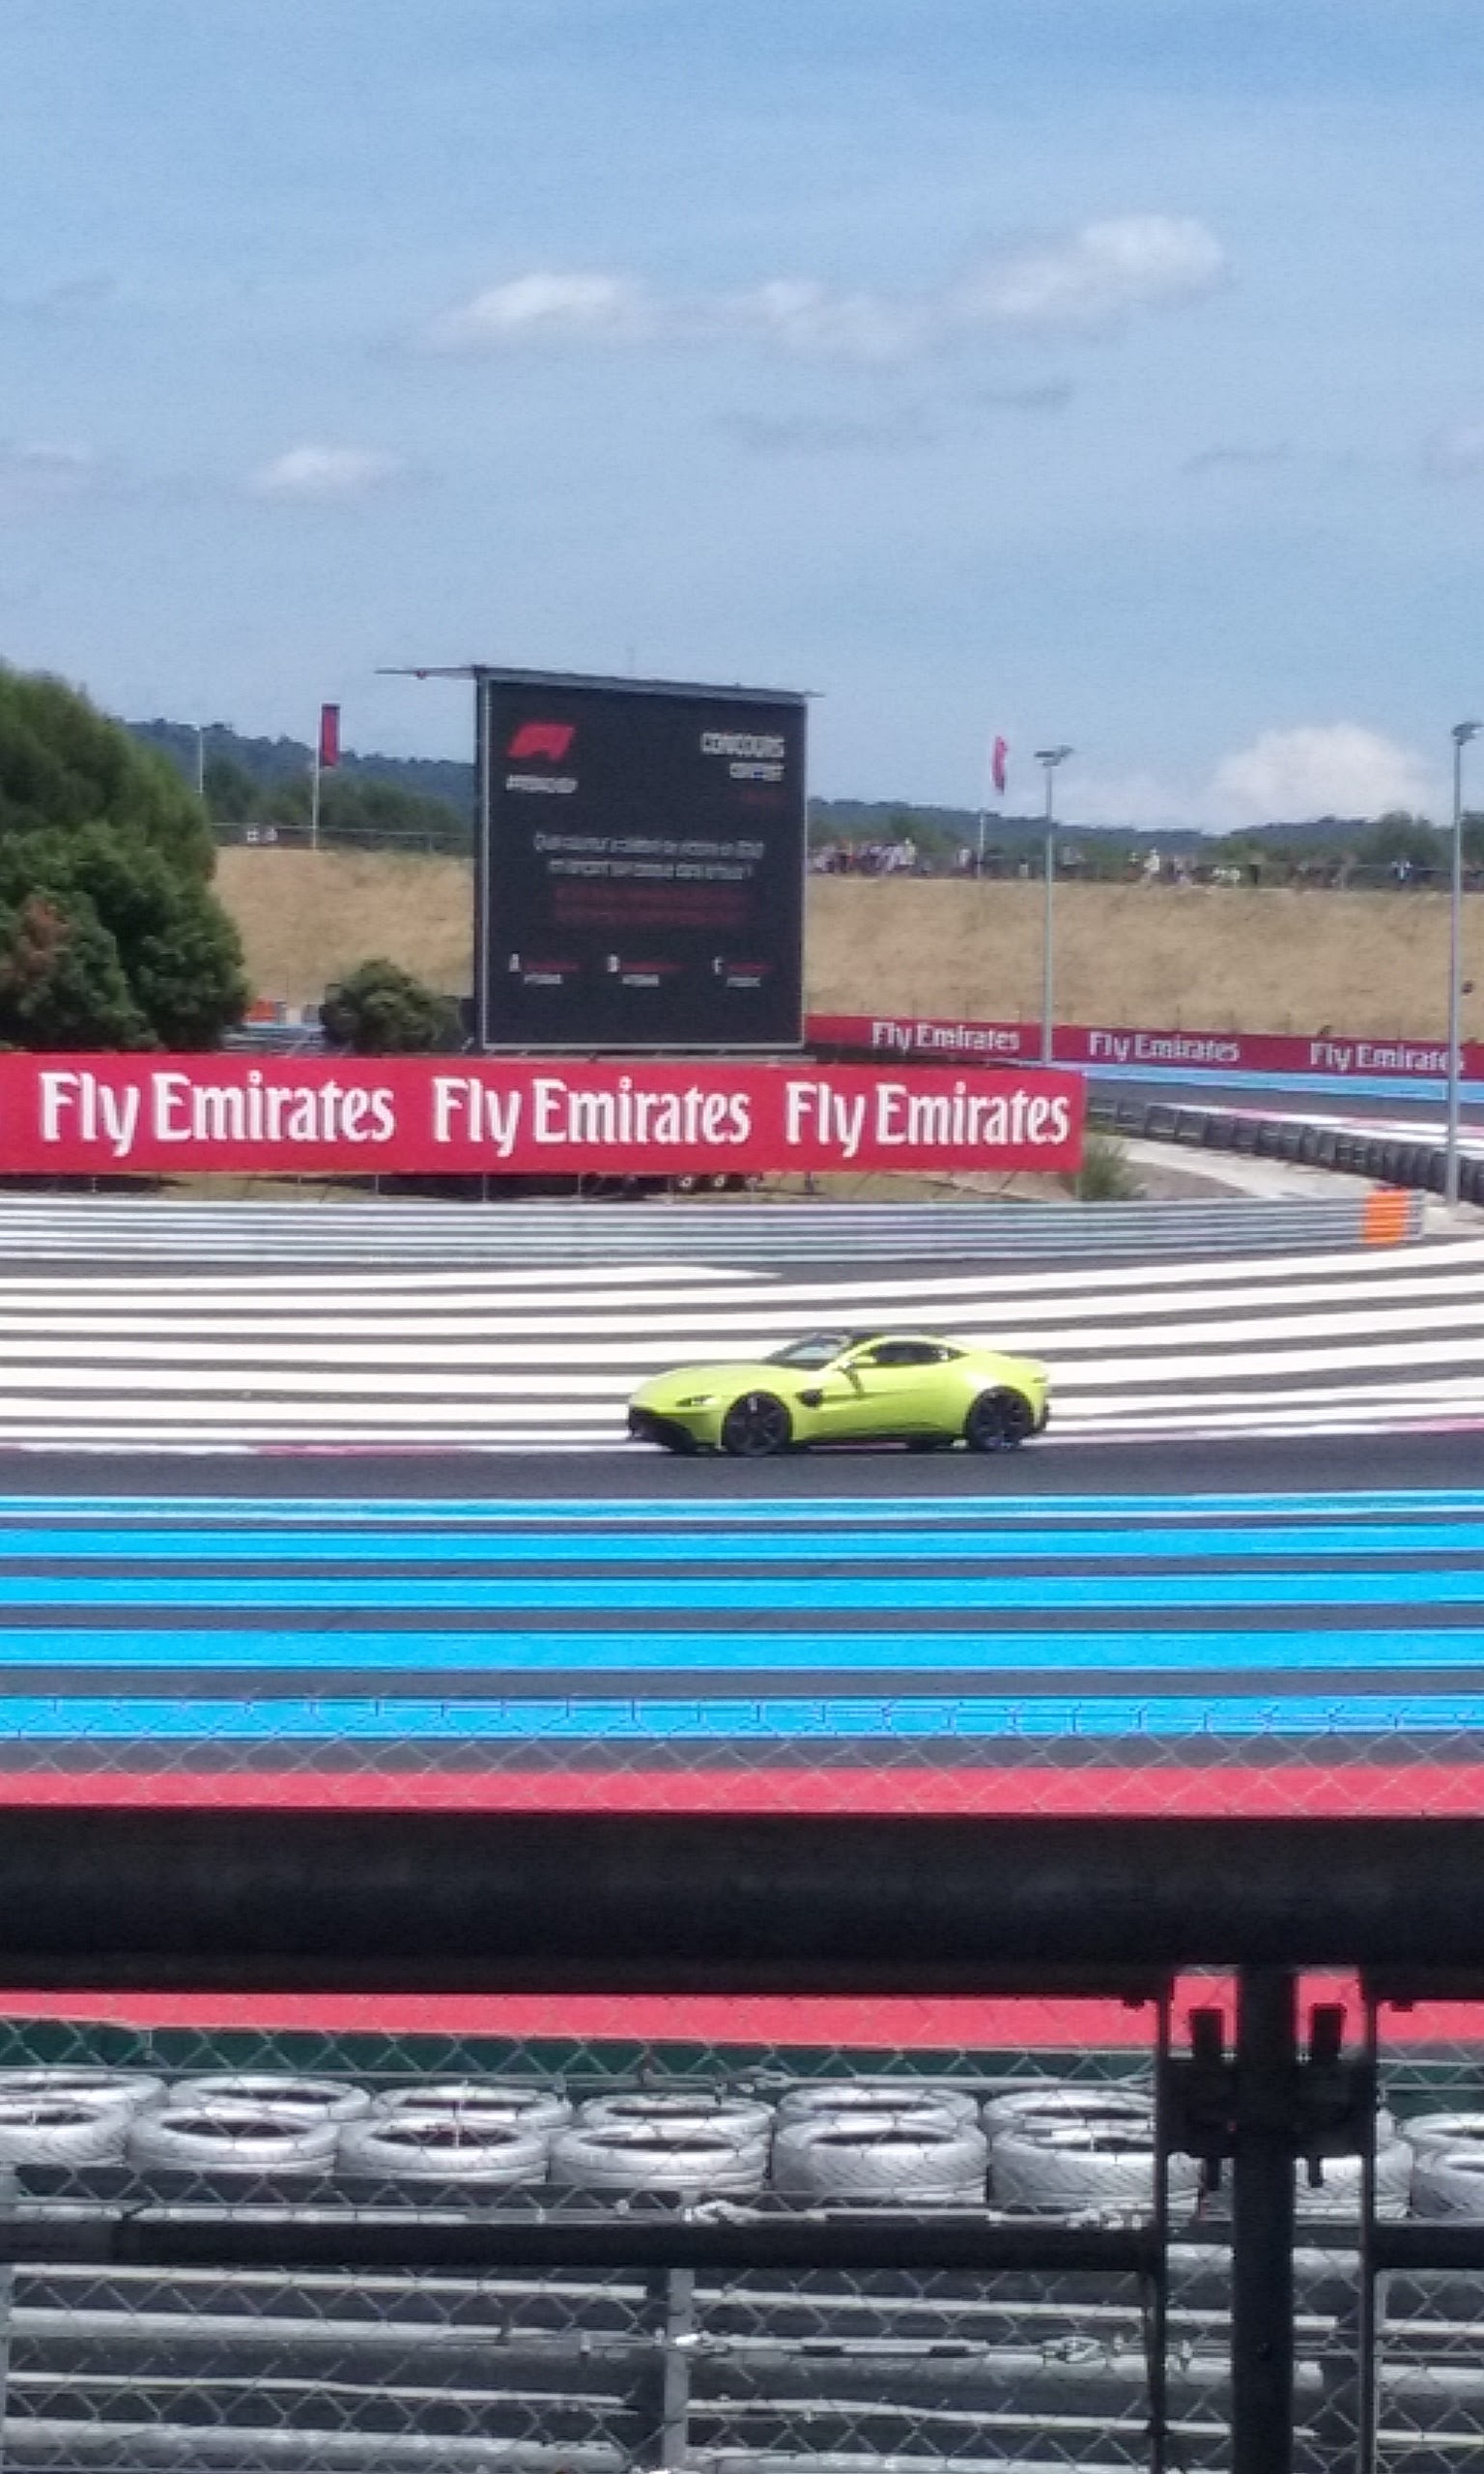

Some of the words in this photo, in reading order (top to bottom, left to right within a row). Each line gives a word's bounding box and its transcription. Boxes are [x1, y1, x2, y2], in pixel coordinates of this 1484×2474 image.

[871, 1021, 912, 1054] Fly
[916, 1024, 1020, 1050] Emirates
[1089, 1030, 1130, 1062] Fly
[1134, 1034, 1241, 1062] Emirates
[1310, 1042, 1353, 1074] Fly
[39, 1071, 140, 1158] Fly
[152, 1069, 396, 1142] Emirates
[432, 1076, 523, 1158] Fly
[532, 1076, 751, 1143] Emirates
[785, 1081, 866, 1158] Fly
[875, 1080, 1070, 1146] Emirates
